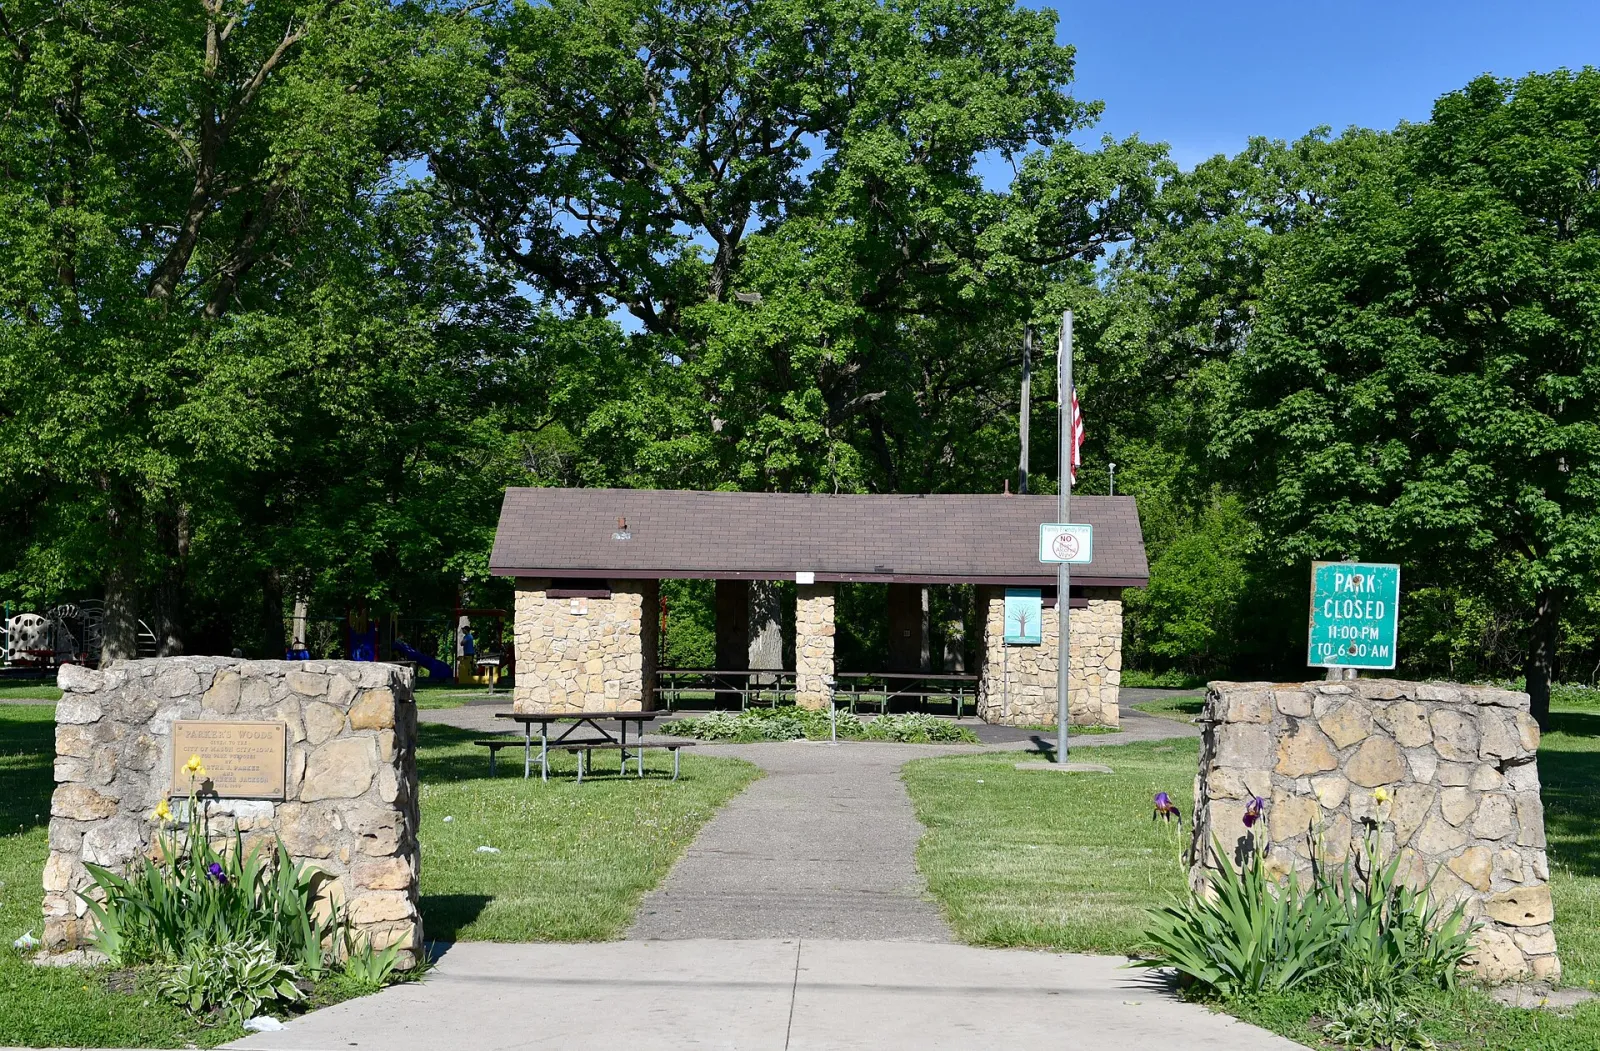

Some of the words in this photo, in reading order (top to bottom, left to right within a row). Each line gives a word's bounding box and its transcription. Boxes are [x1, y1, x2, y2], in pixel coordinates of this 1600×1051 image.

[1334, 573, 1376, 593] PARK
[1323, 599, 1385, 620] CLOSED
[1328, 625, 1358, 639] 11:00
[1361, 626, 1379, 640] PM
[1317, 642, 1332, 656] TO
[1370, 644, 1389, 658] AM
[185, 730, 232, 739] PARKER'S
[238, 730, 273, 739] WOODS
